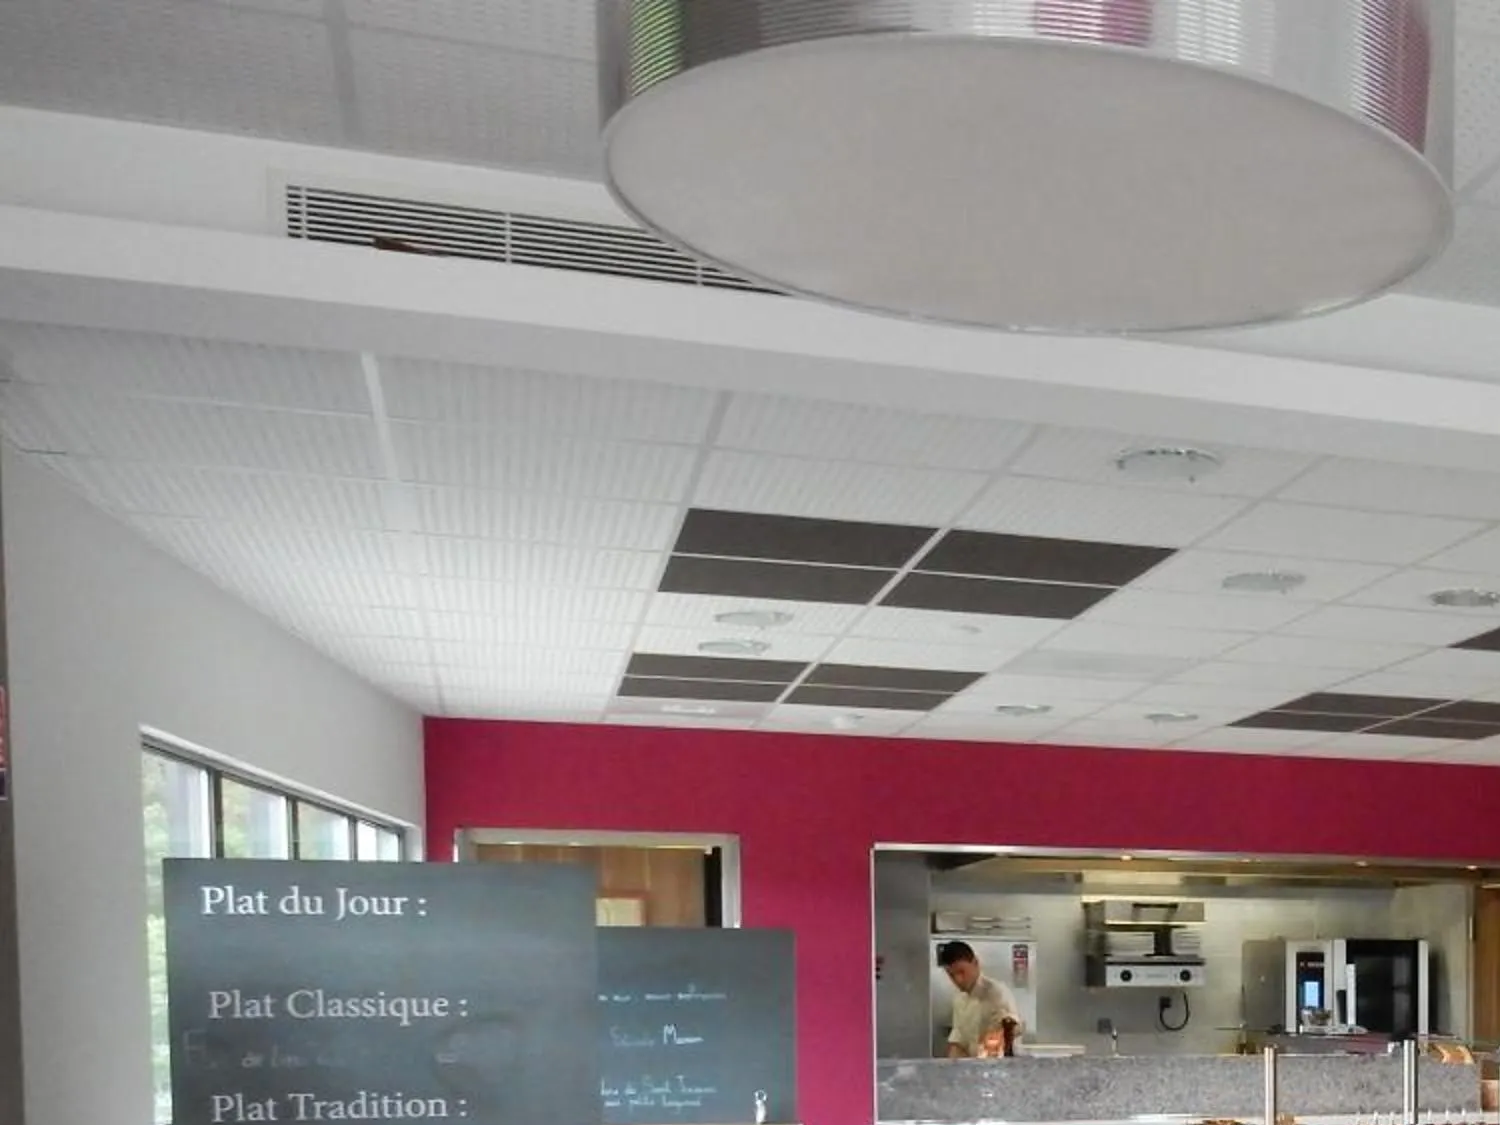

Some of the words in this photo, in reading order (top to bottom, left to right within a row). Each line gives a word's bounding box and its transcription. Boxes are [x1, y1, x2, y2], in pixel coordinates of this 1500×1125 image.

[202, 886, 268, 917] Plat
[279, 886, 324, 917] du
[334, 887, 409, 922] Jour
[208, 990, 274, 1020] Plat
[287, 989, 450, 1026] Classique
[211, 1094, 278, 1123] Plat
[288, 1090, 449, 1120] Tradition
